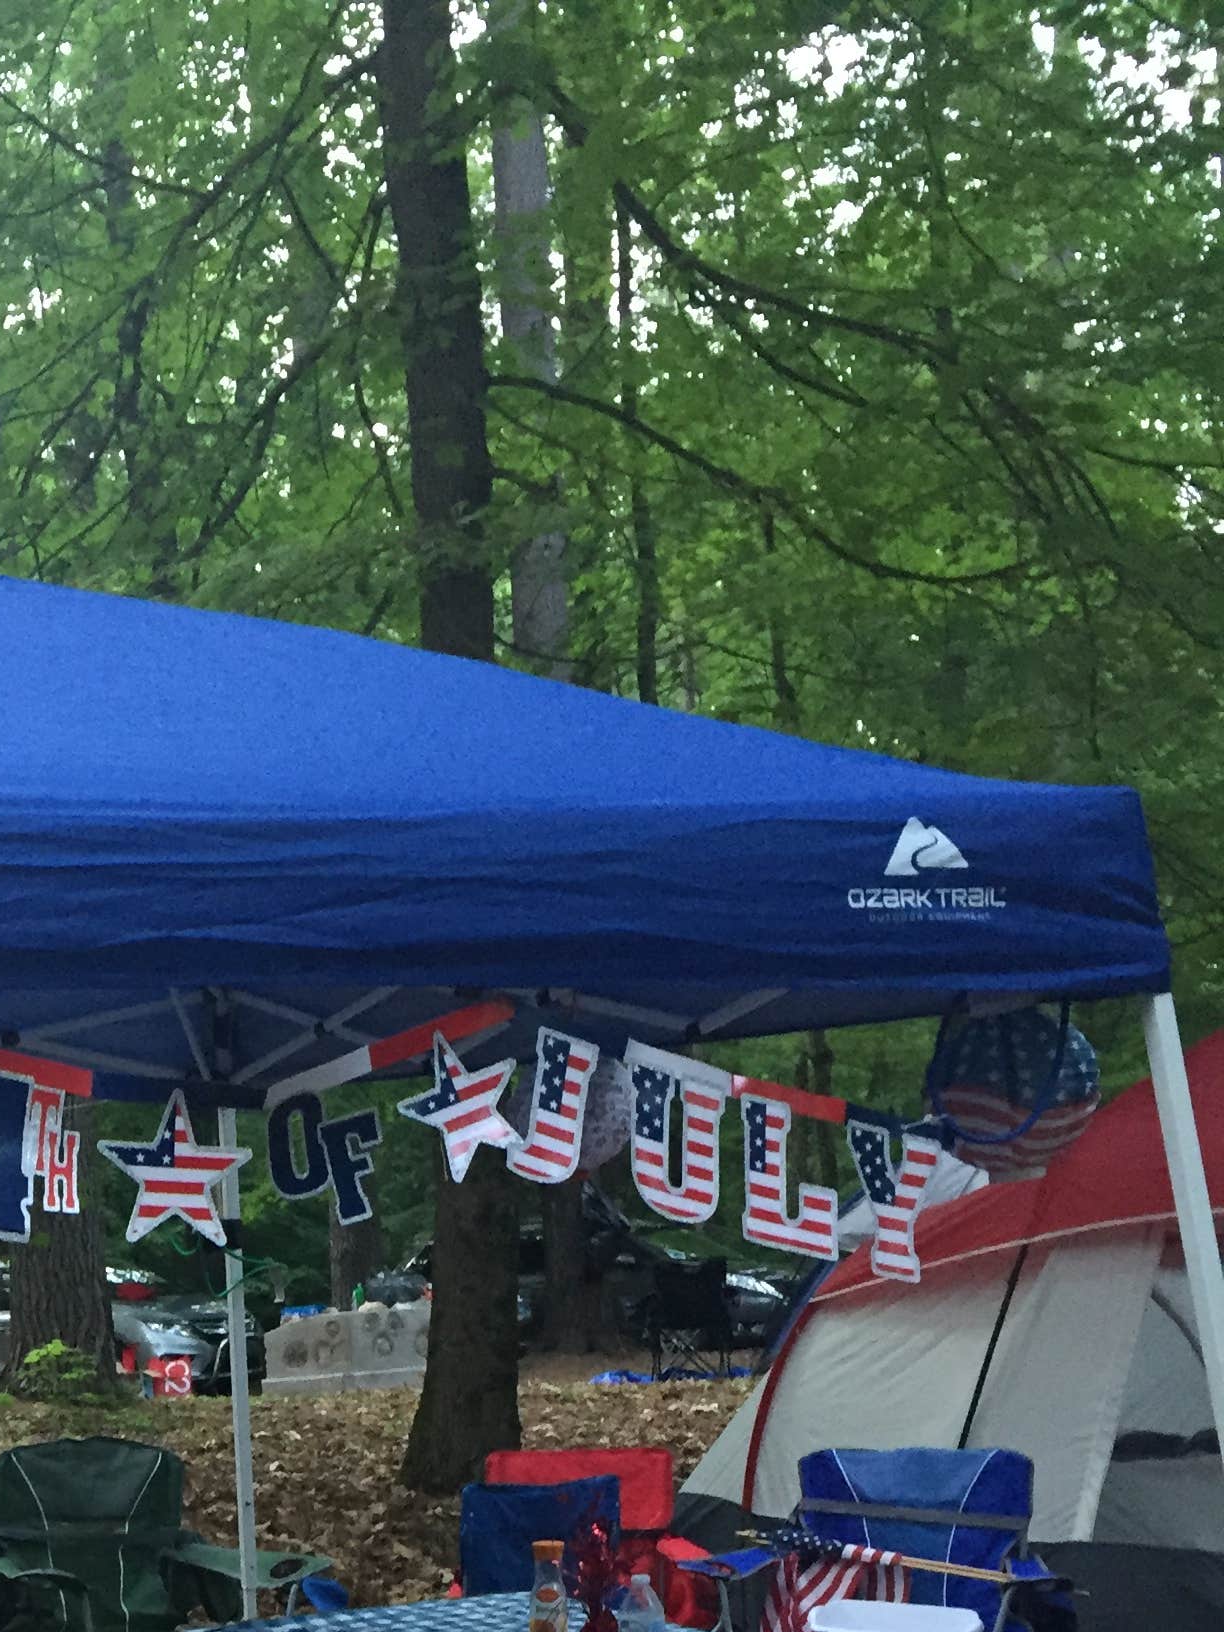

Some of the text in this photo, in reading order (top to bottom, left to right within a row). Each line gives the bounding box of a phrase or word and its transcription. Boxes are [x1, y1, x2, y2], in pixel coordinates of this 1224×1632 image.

[847, 888, 1007, 908] OZARK TRAIL
[268, 1092, 381, 1225] OF
[506, 1026, 941, 1283] JULY
